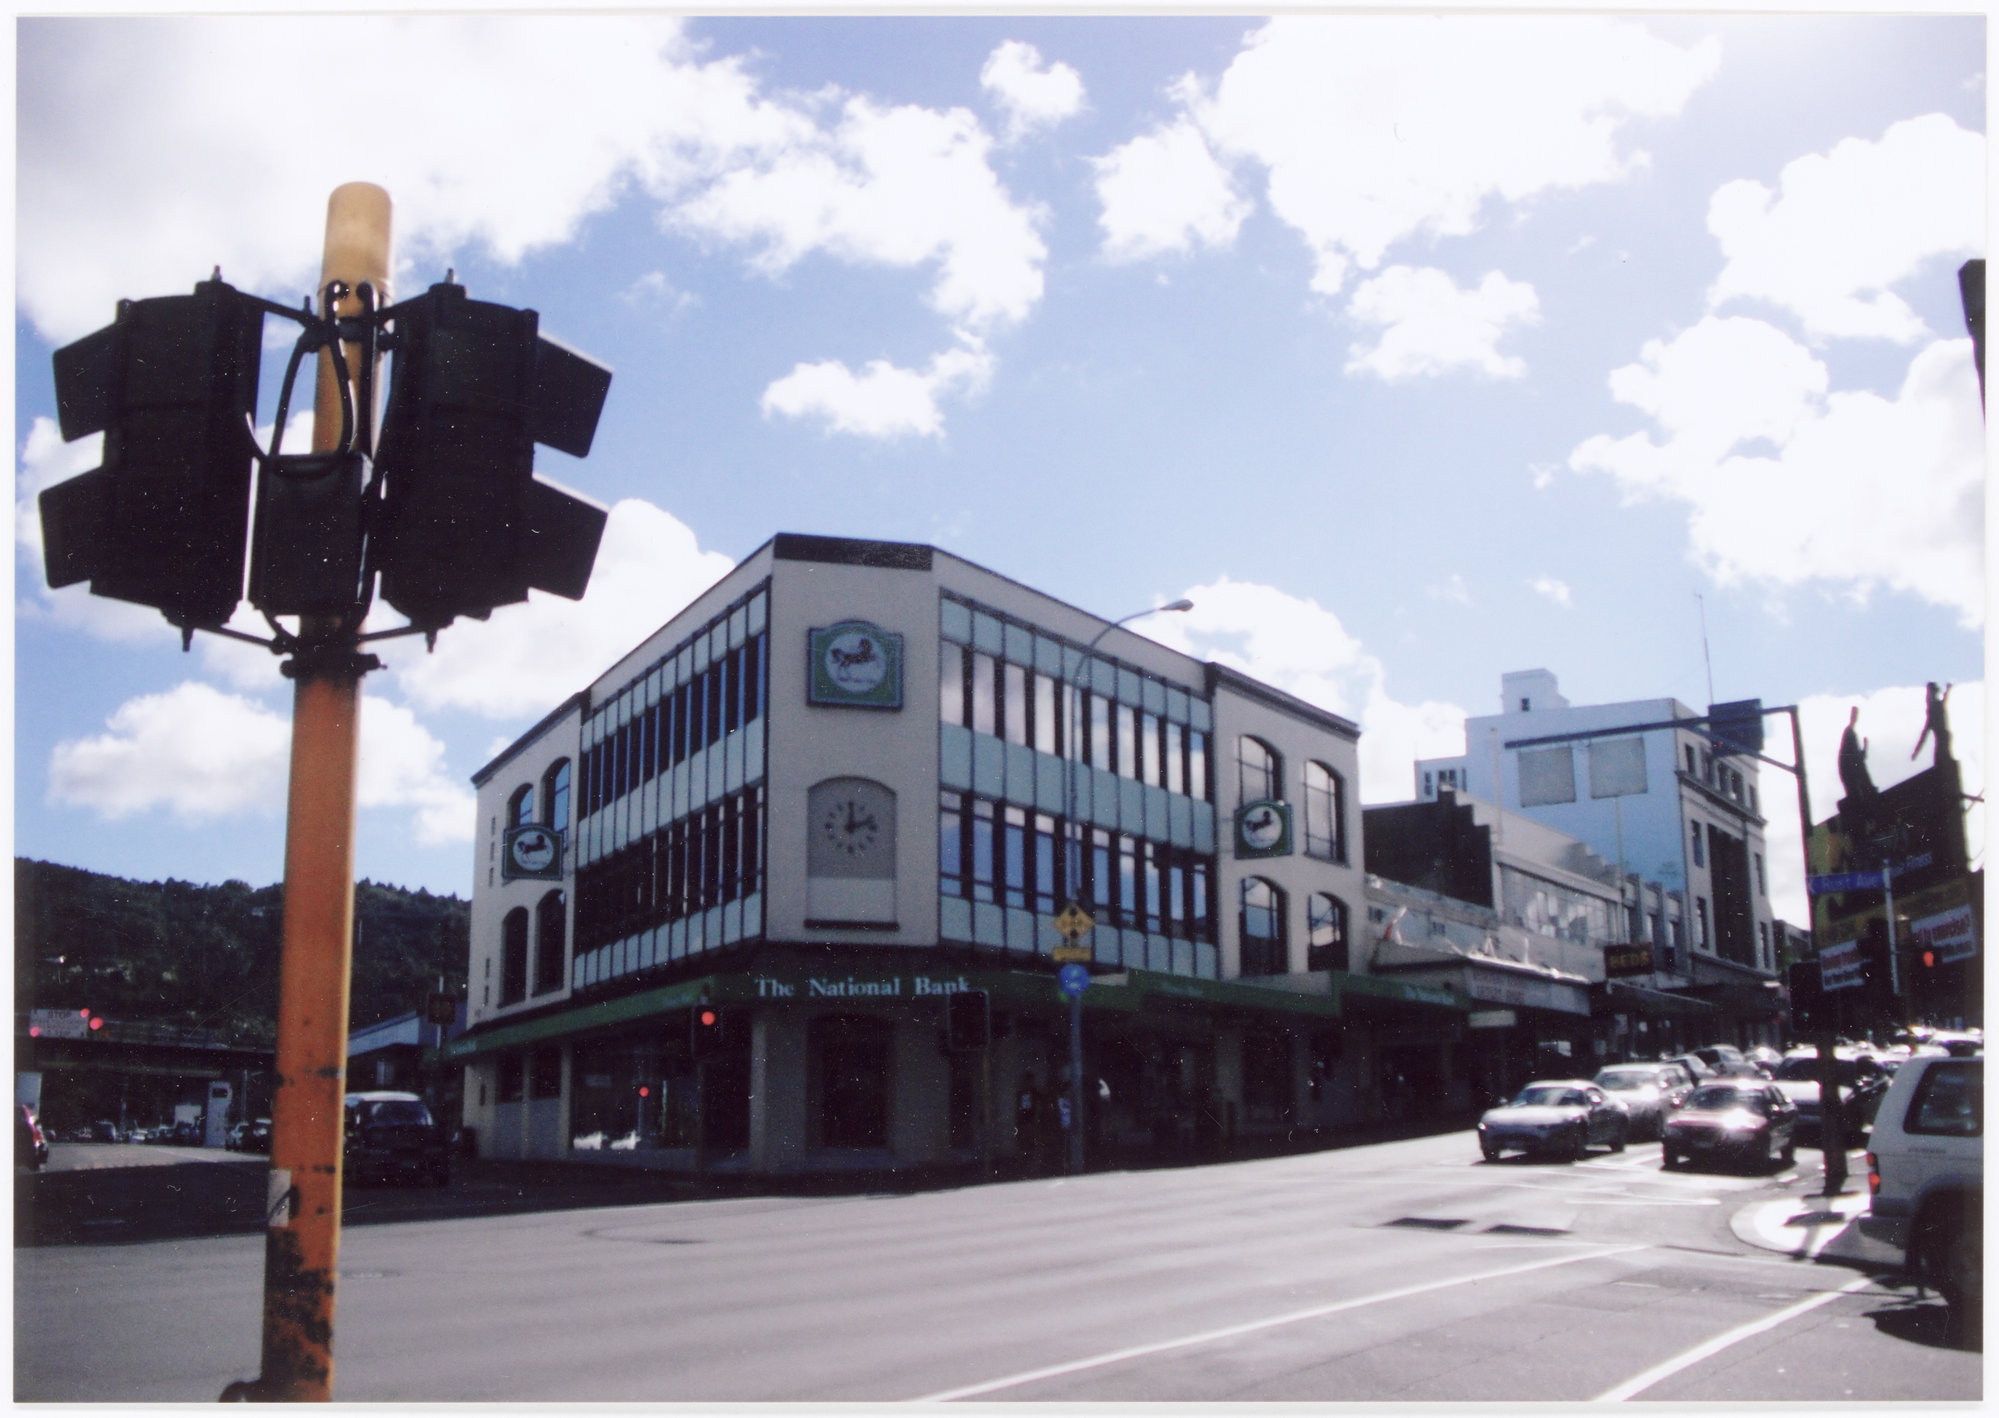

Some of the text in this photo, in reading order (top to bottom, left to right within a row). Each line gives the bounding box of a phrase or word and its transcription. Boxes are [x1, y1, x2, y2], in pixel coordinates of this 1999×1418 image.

[754, 975, 970, 998] The National Bank
